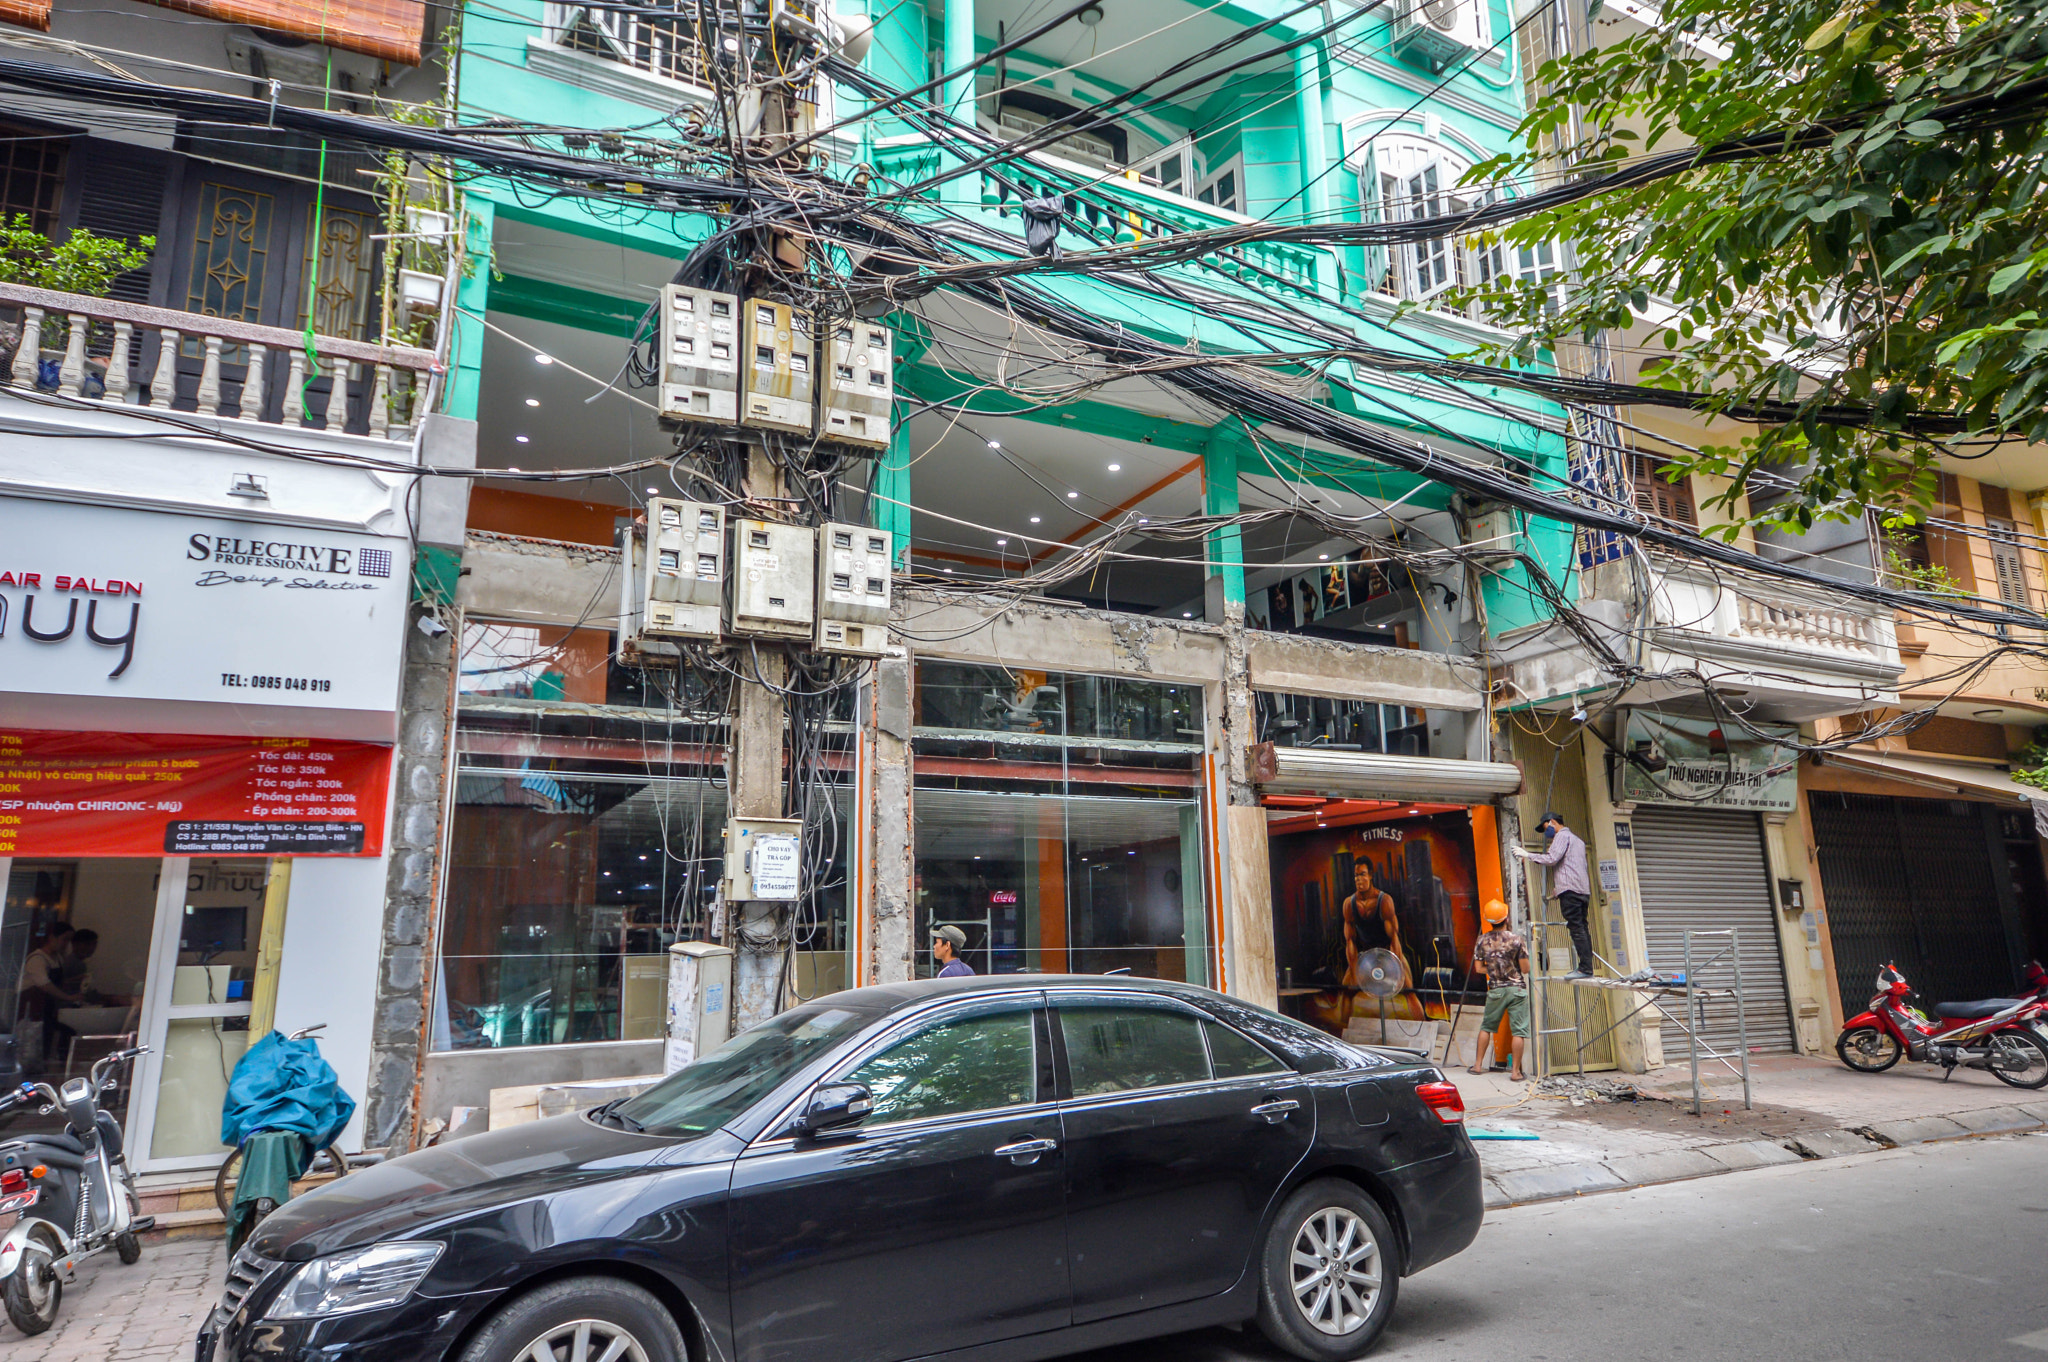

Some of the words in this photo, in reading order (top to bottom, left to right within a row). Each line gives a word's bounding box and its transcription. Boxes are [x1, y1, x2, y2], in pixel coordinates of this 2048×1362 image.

[187, 533, 352, 574] SELECTIVE
[215, 553, 324, 573] PROFESSIONAL
[195, 570, 283, 587] Being
[284, 577, 379, 590] Selective
[55, 576, 142, 596] SALON
[221, 673, 248, 687] TEL:
[251, 675, 281, 689] 0985
[285, 677, 307, 691] 048
[311, 679, 331, 692] 919
[259, 751, 280, 760] Tóc
[283, 752, 305, 760] dài:
[307, 752, 334, 761] 450k
[162, 759, 169, 768] 5
[257, 764, 279, 774] Tóc
[299, 766, 326, 774] 350k
[154, 772, 183, 781] 250K
[255, 778, 277, 787] Tóc
[316, 780, 343, 788] 300k
[330, 793, 356, 802] 200k
[0, 800, 24, 810] SP
[26, 800, 74, 813] nhuộm
[252, 804, 269, 816] Ép
[307, 807, 357, 816] 200-300k
[178, 823, 191, 831] CS
[303, 824, 324, 832] Long
[1362, 827, 1403, 841] FITNESS
[175, 843, 209, 851] Hotline:
[211, 843, 232, 851] 0985
[233, 843, 249, 851] 048
[250, 843, 266, 851] 919
